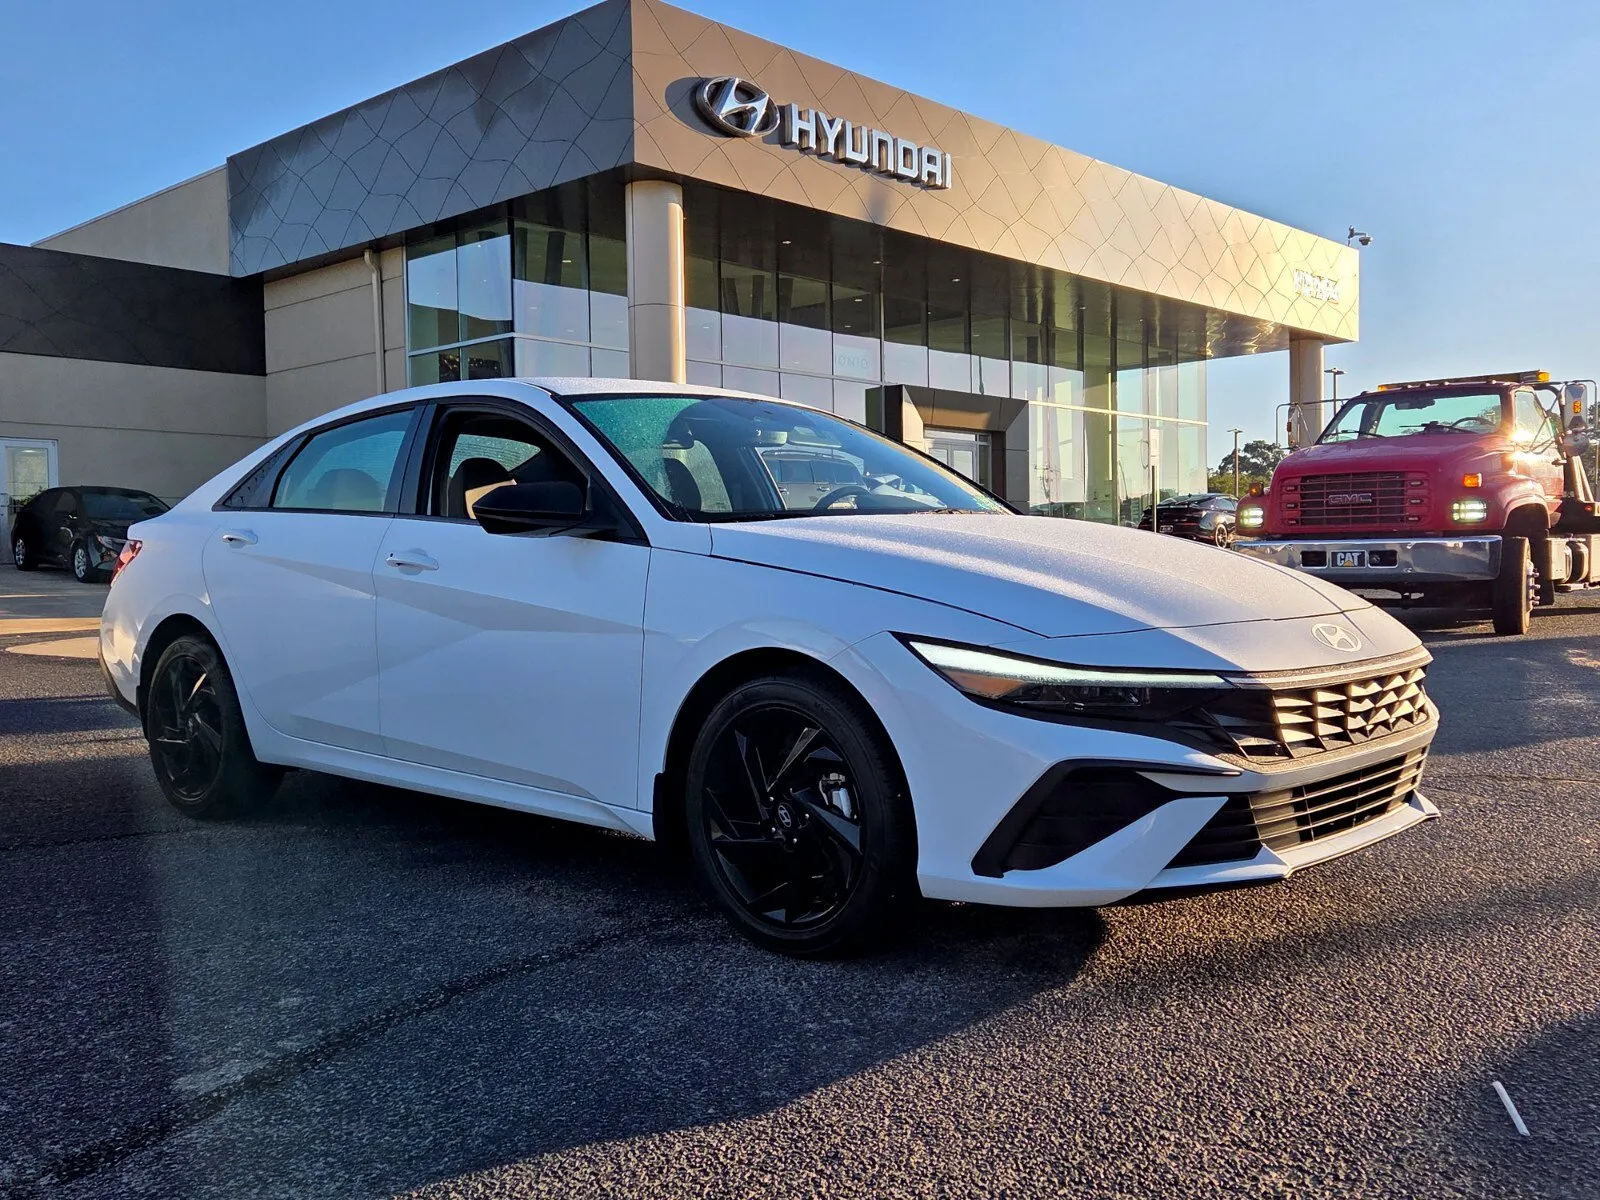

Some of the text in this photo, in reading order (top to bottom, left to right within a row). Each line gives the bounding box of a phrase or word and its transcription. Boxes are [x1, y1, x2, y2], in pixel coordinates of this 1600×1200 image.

[786, 103, 952, 189] HYUNDAI
[1329, 493, 1372, 504] GMC
[1337, 552, 1361, 567] CAT
